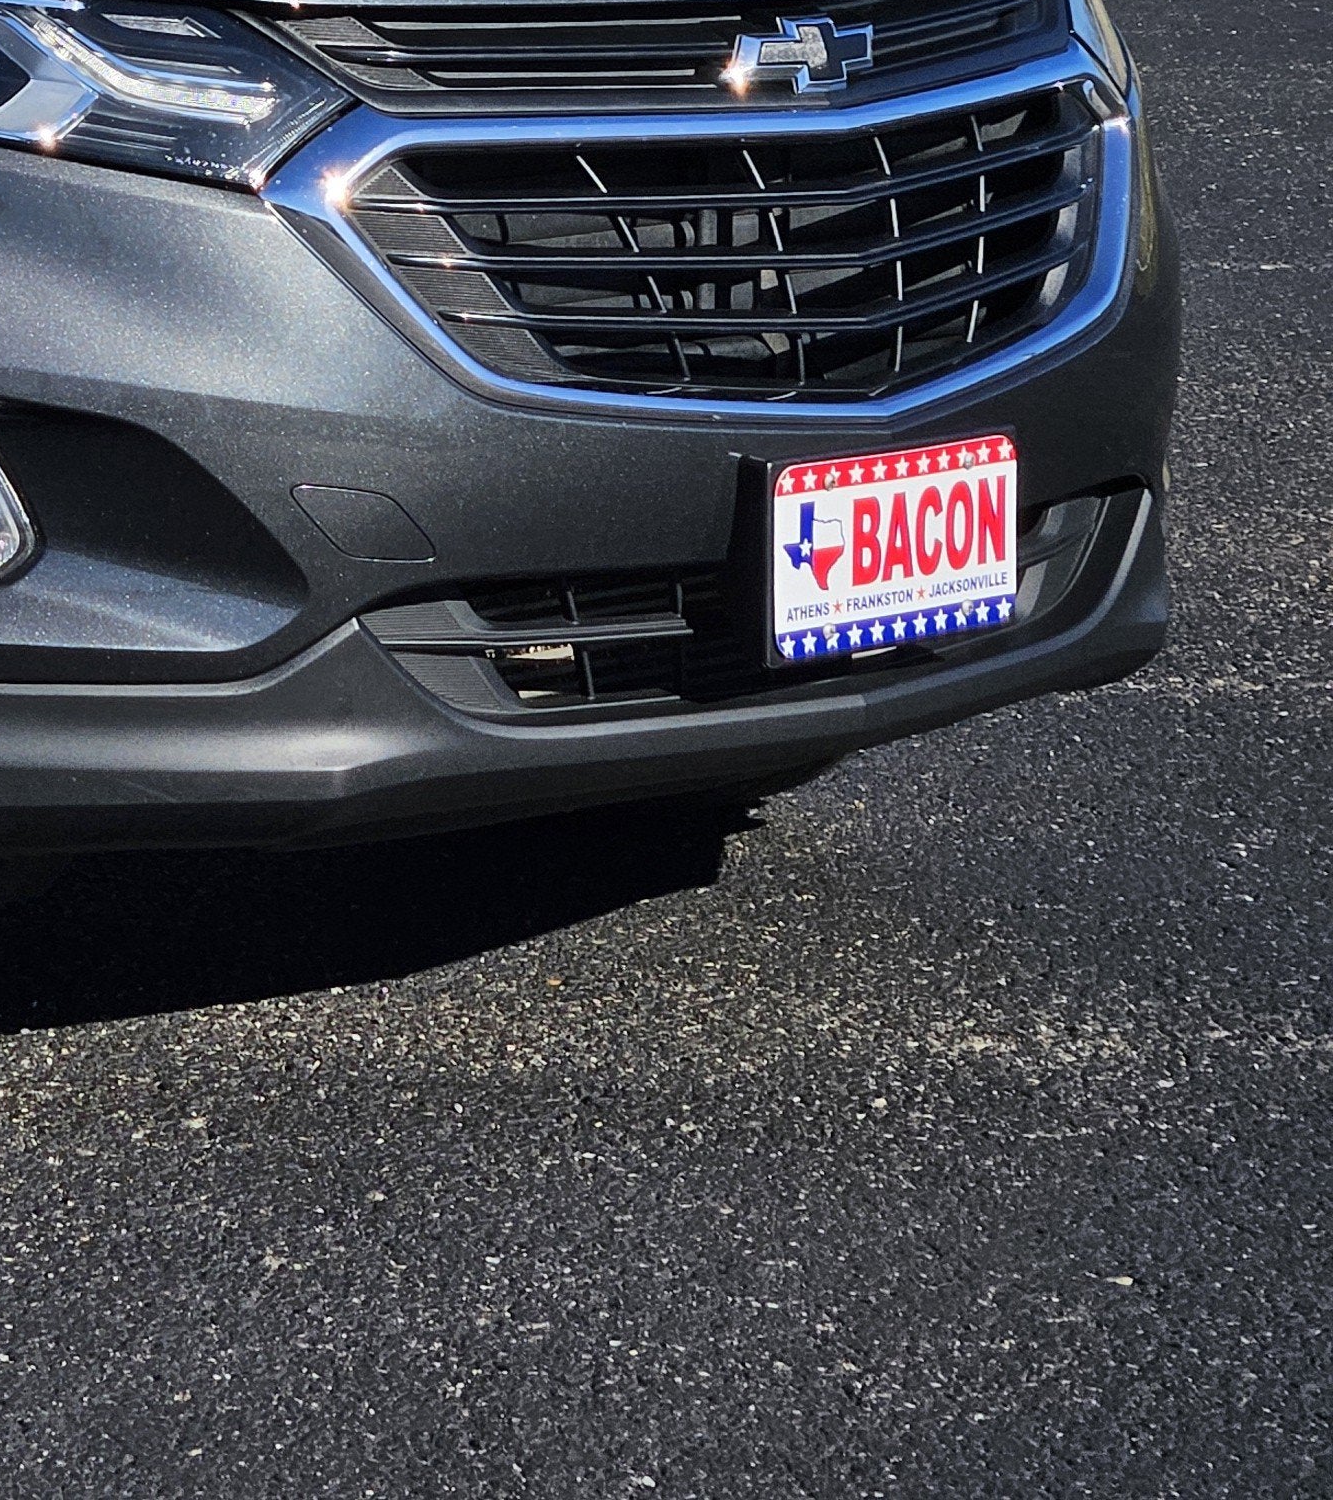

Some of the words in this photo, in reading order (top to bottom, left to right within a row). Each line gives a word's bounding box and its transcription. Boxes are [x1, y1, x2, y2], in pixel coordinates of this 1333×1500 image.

[852, 475, 1006, 586] BACON
[787, 602, 830, 622] ATHENS
[847, 589, 914, 612] FRANKSTON
[929, 572, 1008, 598] JACKSONVILLE
